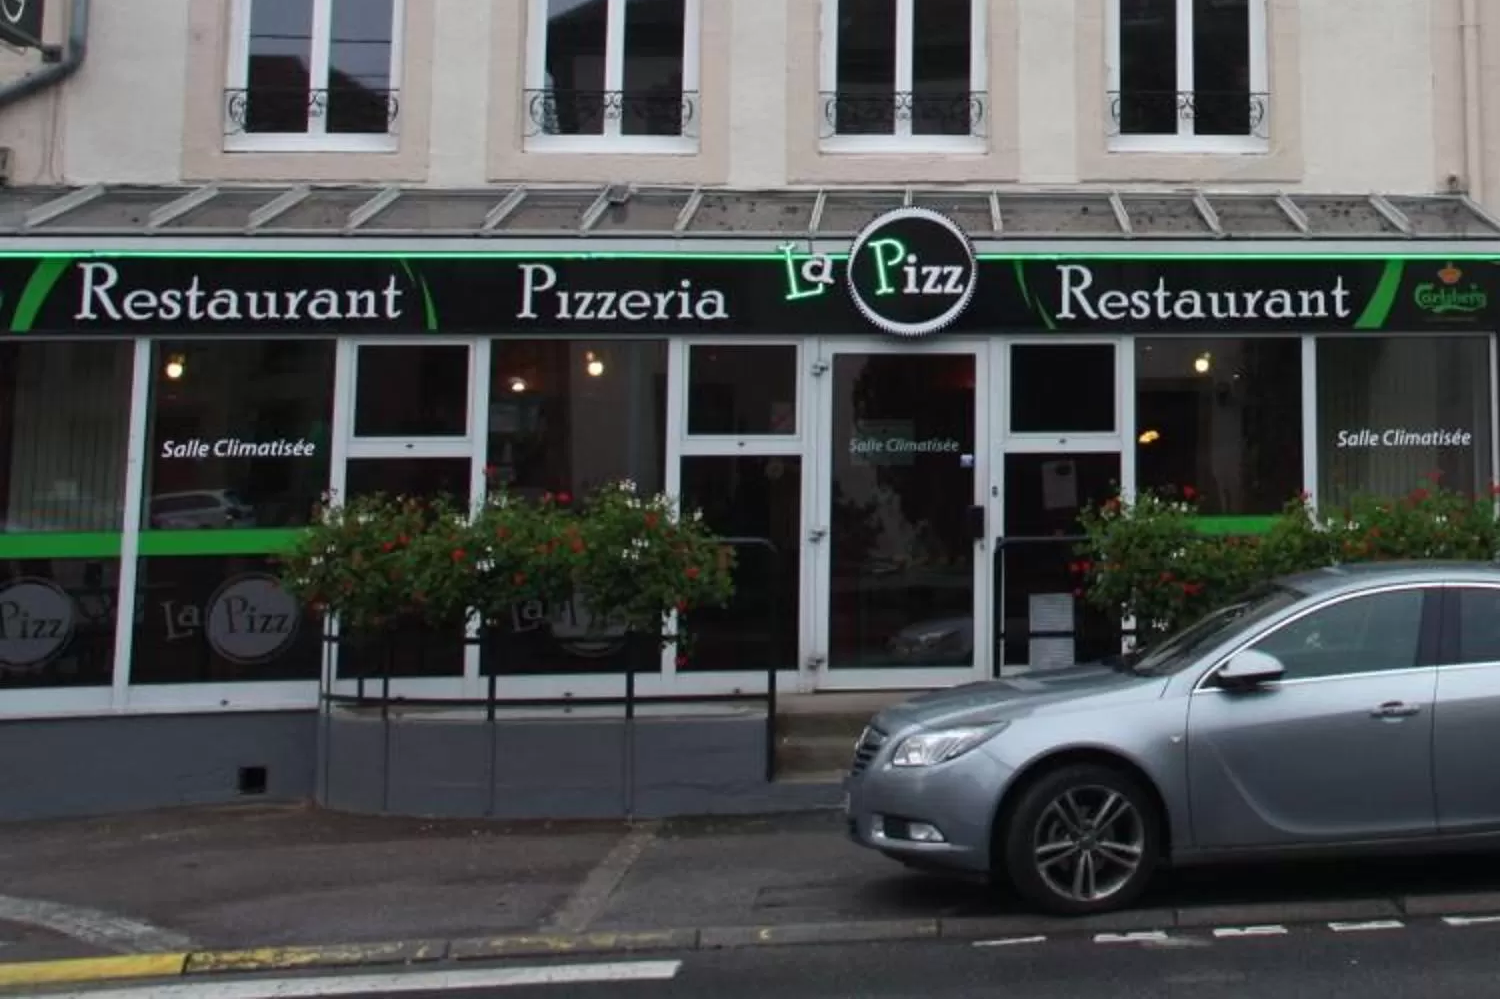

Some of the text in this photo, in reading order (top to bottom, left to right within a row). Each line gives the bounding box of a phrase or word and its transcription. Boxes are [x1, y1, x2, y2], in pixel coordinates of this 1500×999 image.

[74, 261, 402, 321] Restaurant
[778, 241, 834, 300] La
[868, 238, 965, 295] Pizz
[516, 264, 729, 321] Pizzeria
[1056, 264, 1350, 319] Restaurant
[161, 438, 316, 459] Salle Climatisée
[849, 438, 883, 453] Salle
[1337, 428, 1472, 447] Salle Climatisée
[160, 599, 202, 643] La
[224, 595, 289, 635] Pizz
